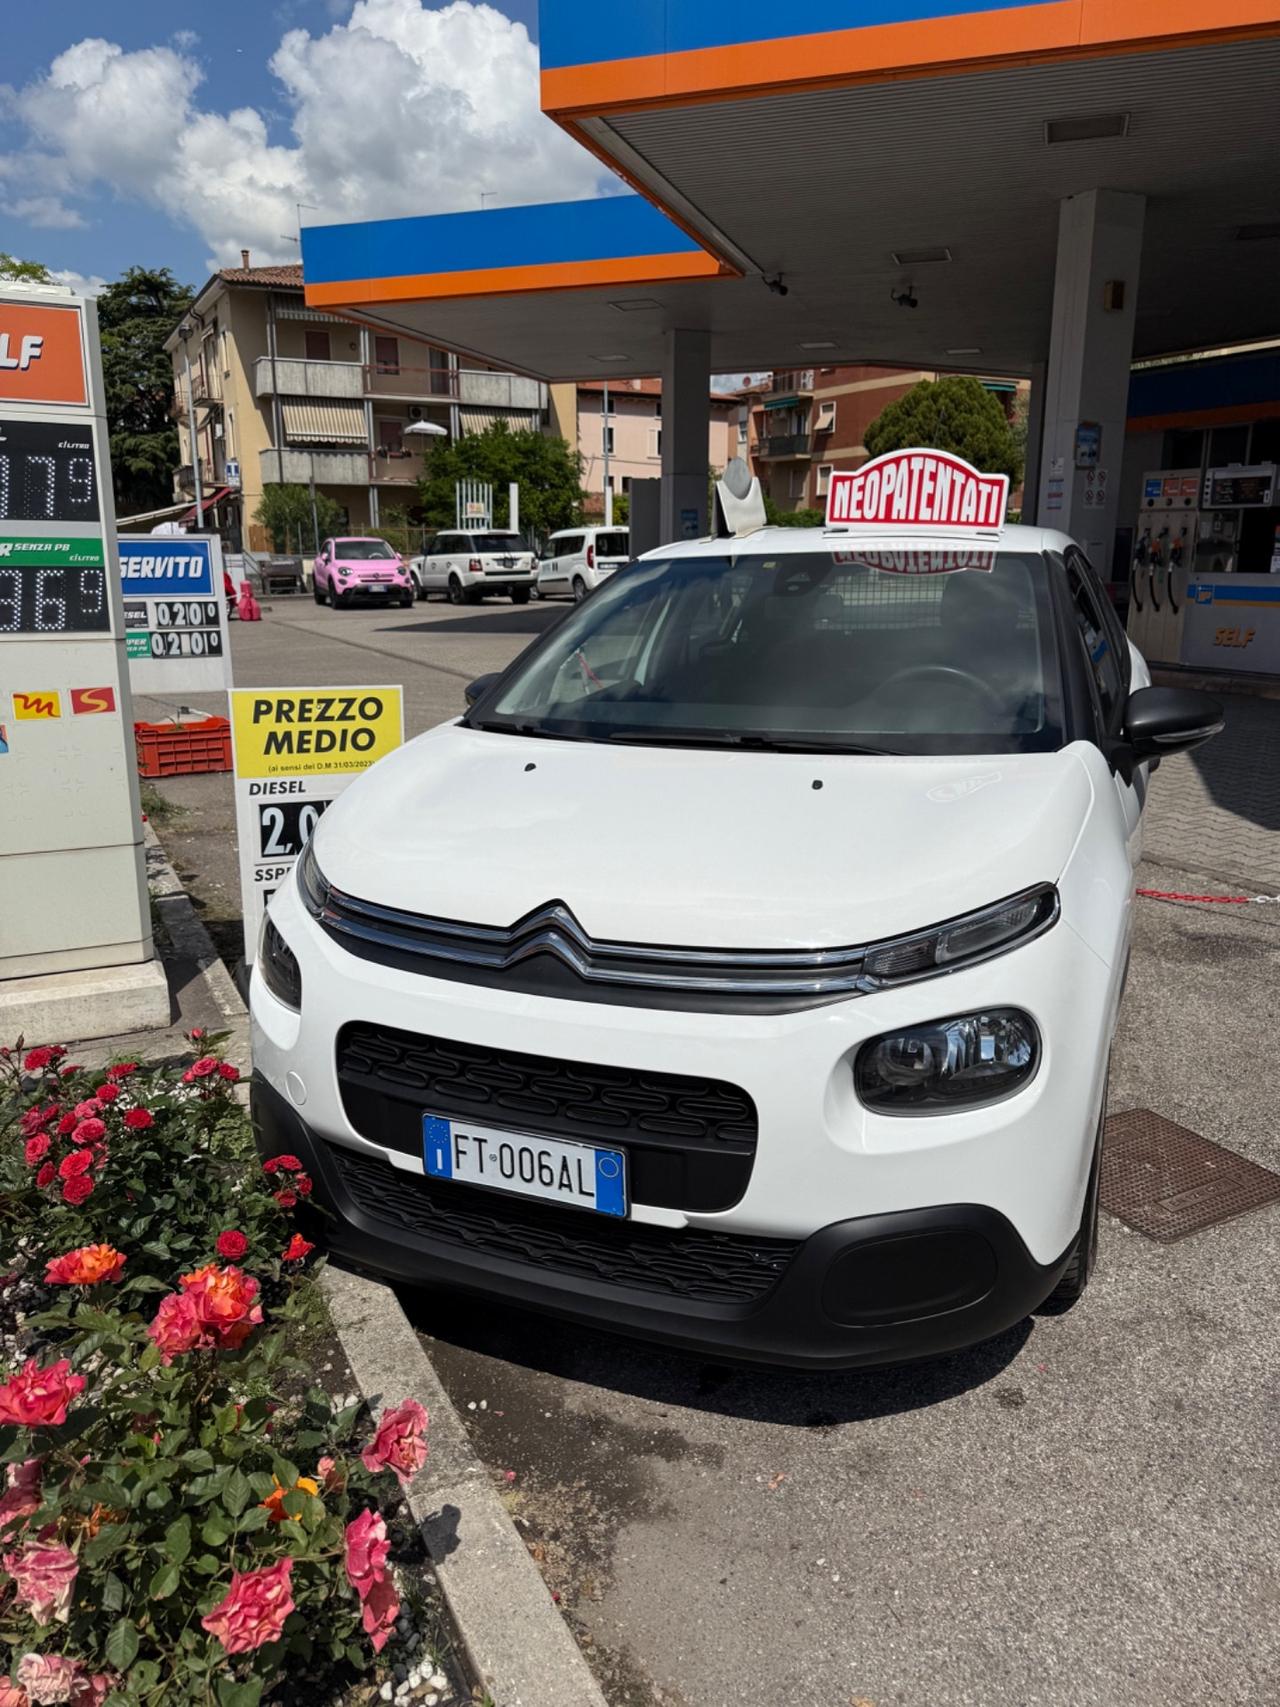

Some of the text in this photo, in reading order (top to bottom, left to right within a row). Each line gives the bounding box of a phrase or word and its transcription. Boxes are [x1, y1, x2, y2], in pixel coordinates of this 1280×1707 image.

[833, 456, 1000, 524] NEOPATENTATI
[14, 543, 52, 551] SENZA
[120, 556, 203, 578] SERVITO
[1213, 626, 1256, 648] SELF
[253, 697, 383, 724] PREZZO
[264, 728, 375, 755] MEDIO
[280, 763, 302, 772] sensi
[249, 780, 306, 796] DIESEL
